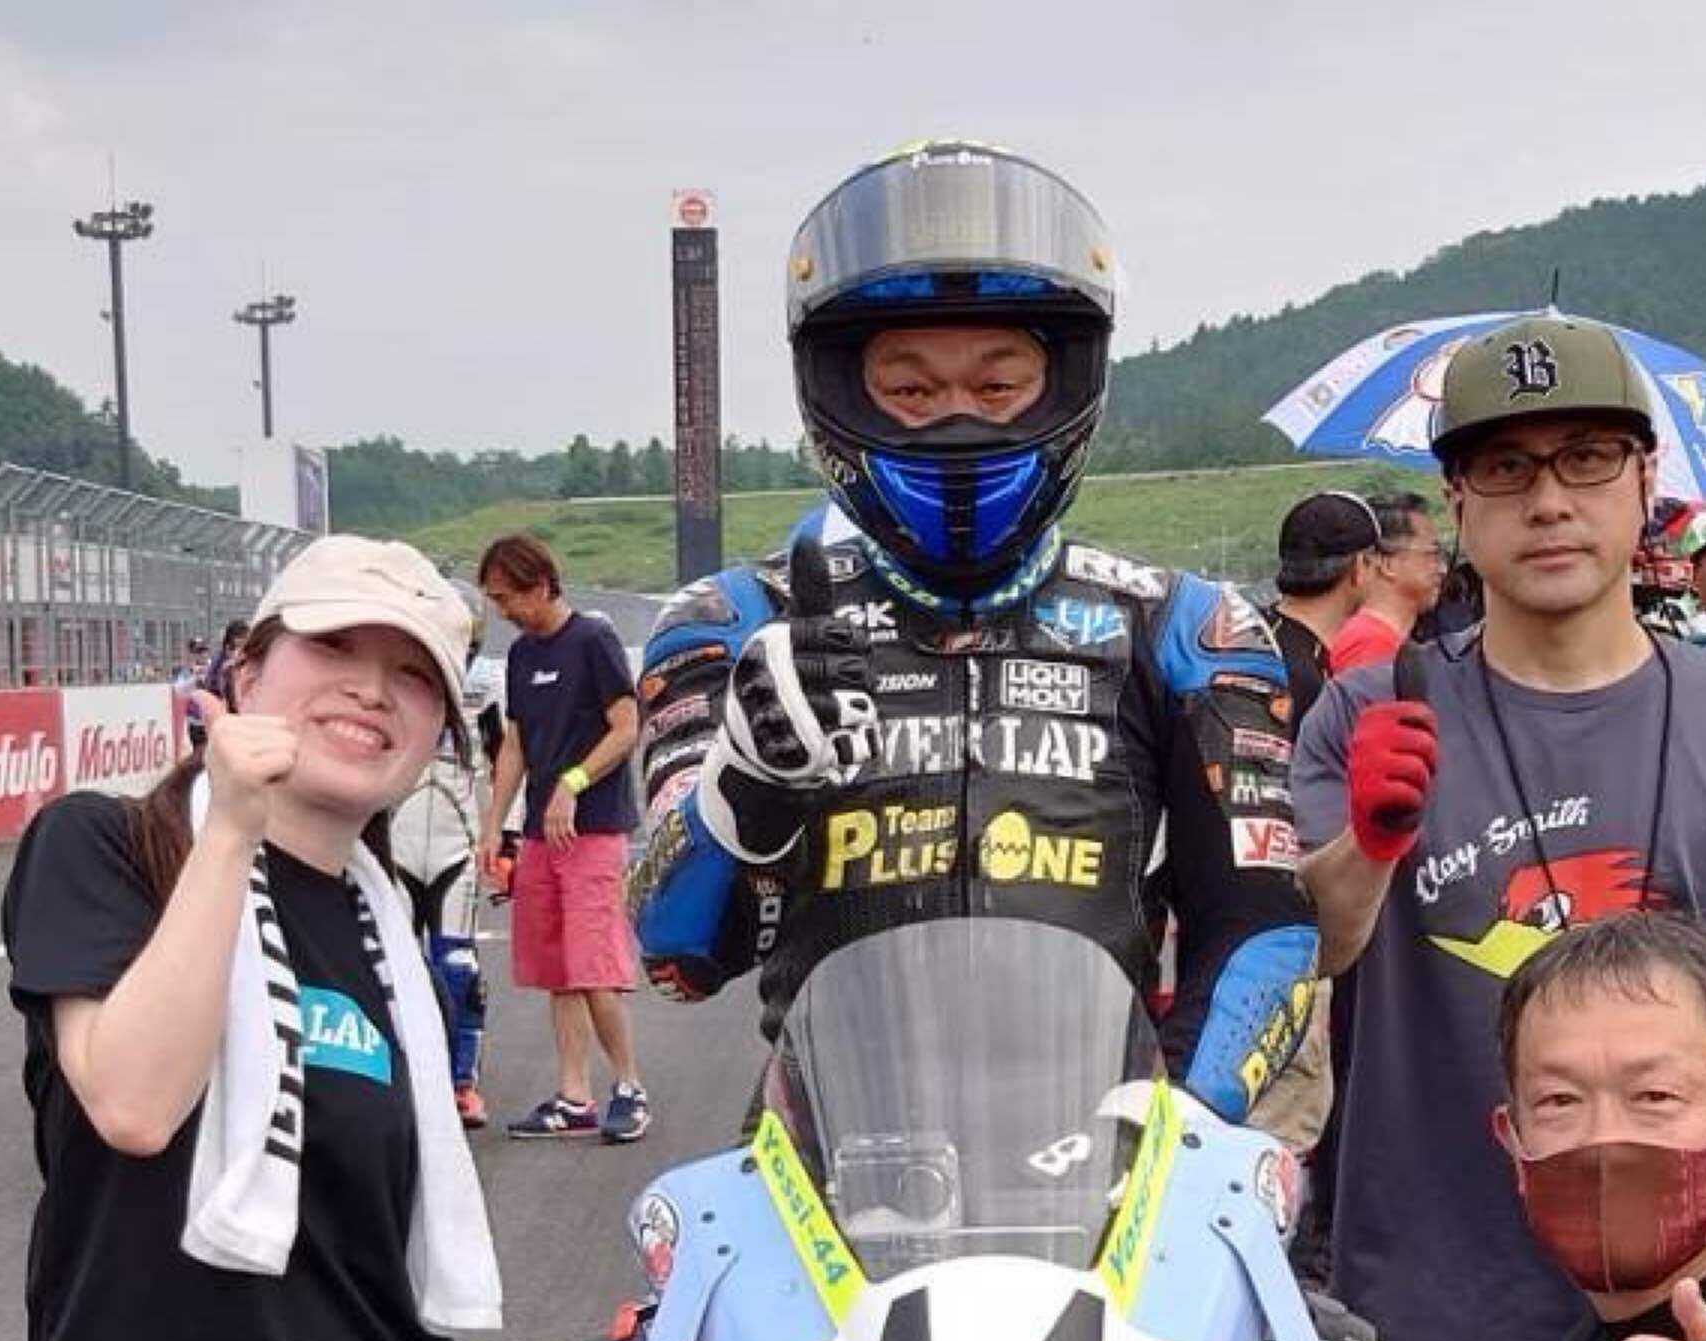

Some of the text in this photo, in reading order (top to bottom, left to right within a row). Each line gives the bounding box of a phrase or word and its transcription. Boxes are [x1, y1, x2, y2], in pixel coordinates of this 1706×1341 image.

[997, 716, 1109, 781] LAP
[1415, 796, 1593, 901] Clay Smith
